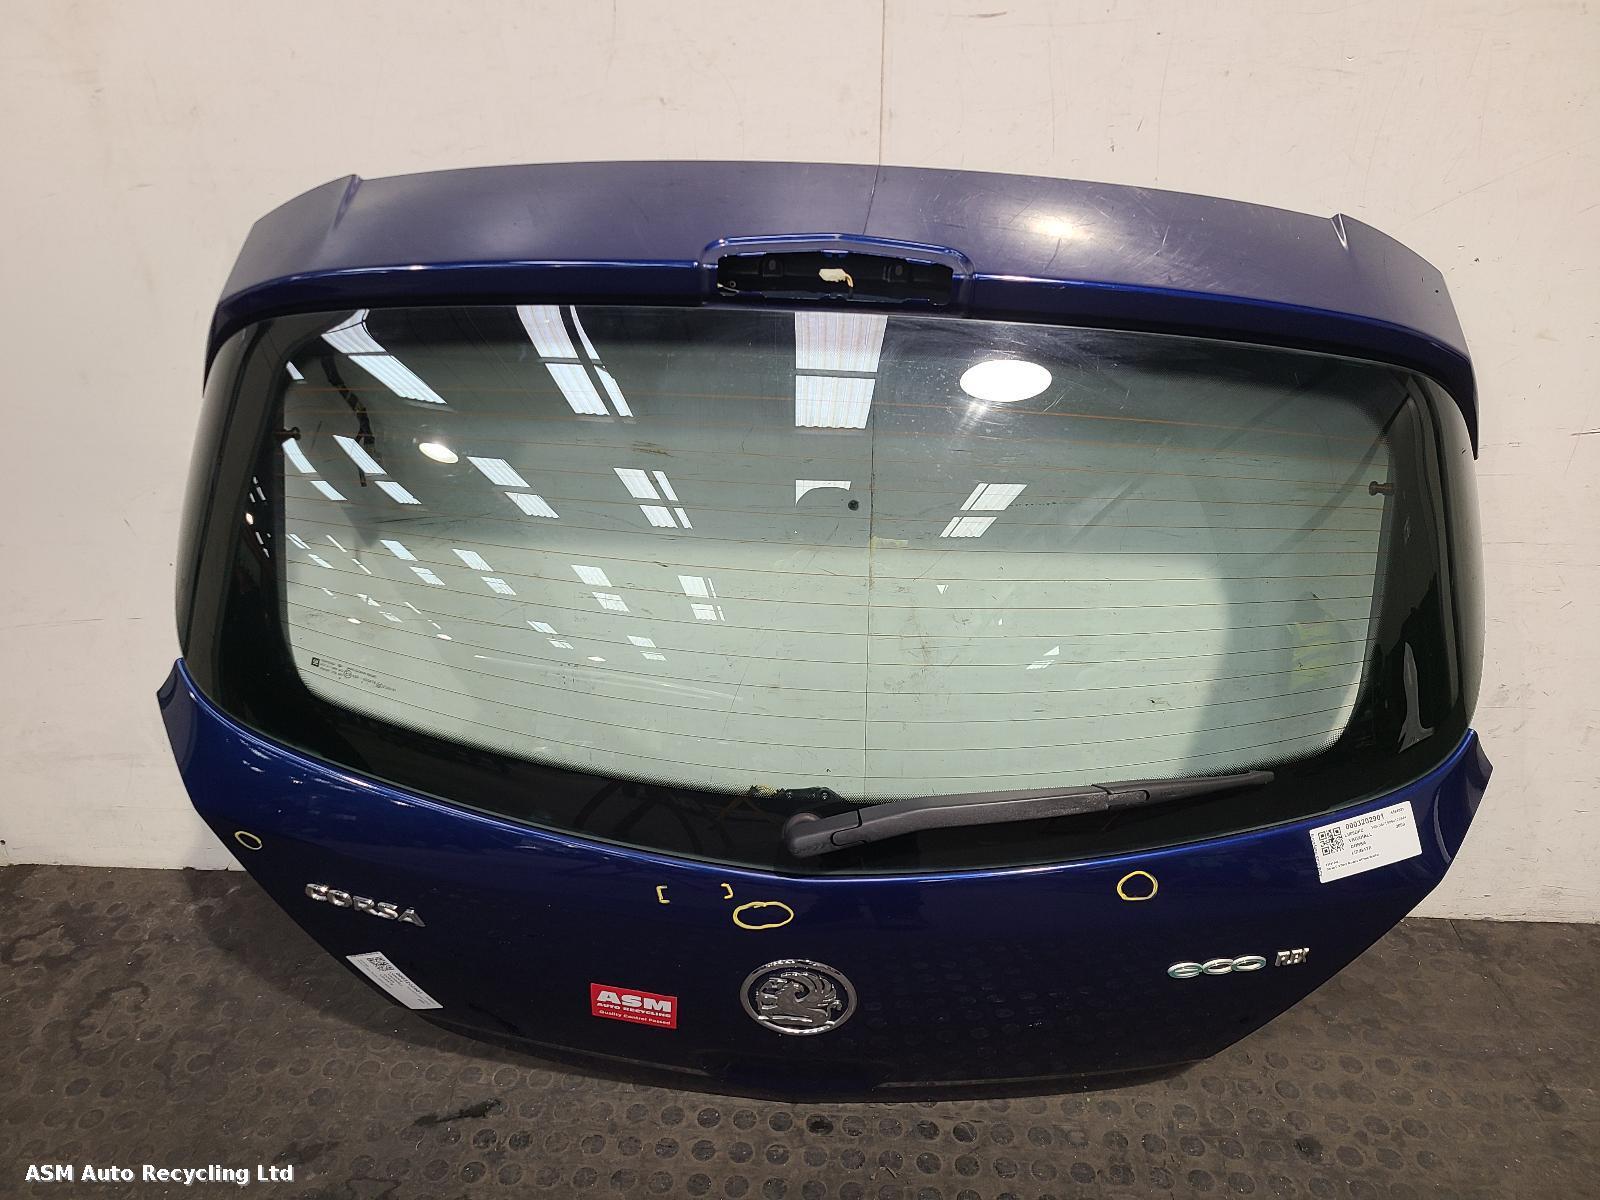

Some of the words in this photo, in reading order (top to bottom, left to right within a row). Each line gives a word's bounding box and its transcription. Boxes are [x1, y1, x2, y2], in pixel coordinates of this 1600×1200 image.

[1345, 813, 1385, 830] 0003202901
[305, 883, 426, 927] CORSA
[596, 990, 672, 1013] ASM
[596, 1002, 621, 1010] AUTO
[622, 1006, 672, 1018] RECYCLING
[599, 1009, 622, 1018] Quality
[623, 1013, 647, 1022] Control
[648, 1017, 671, 1025] Passed
